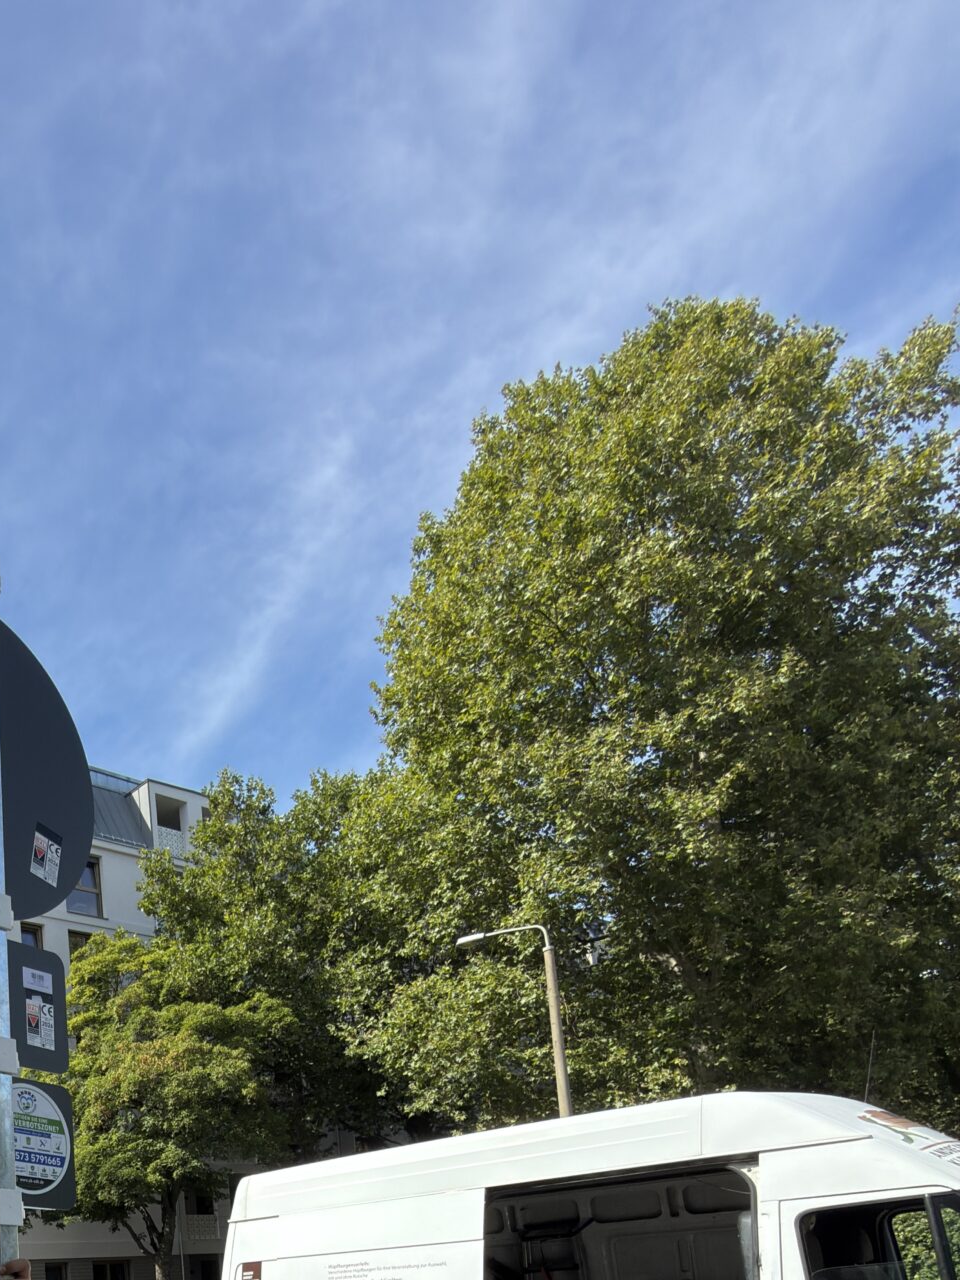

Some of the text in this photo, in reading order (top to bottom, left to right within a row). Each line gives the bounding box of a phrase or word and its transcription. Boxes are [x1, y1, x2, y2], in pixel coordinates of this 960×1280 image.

[14, 1119, 60, 1134] VERBOTSZONE?
[15, 1151, 62, 1166] 573 5791665
